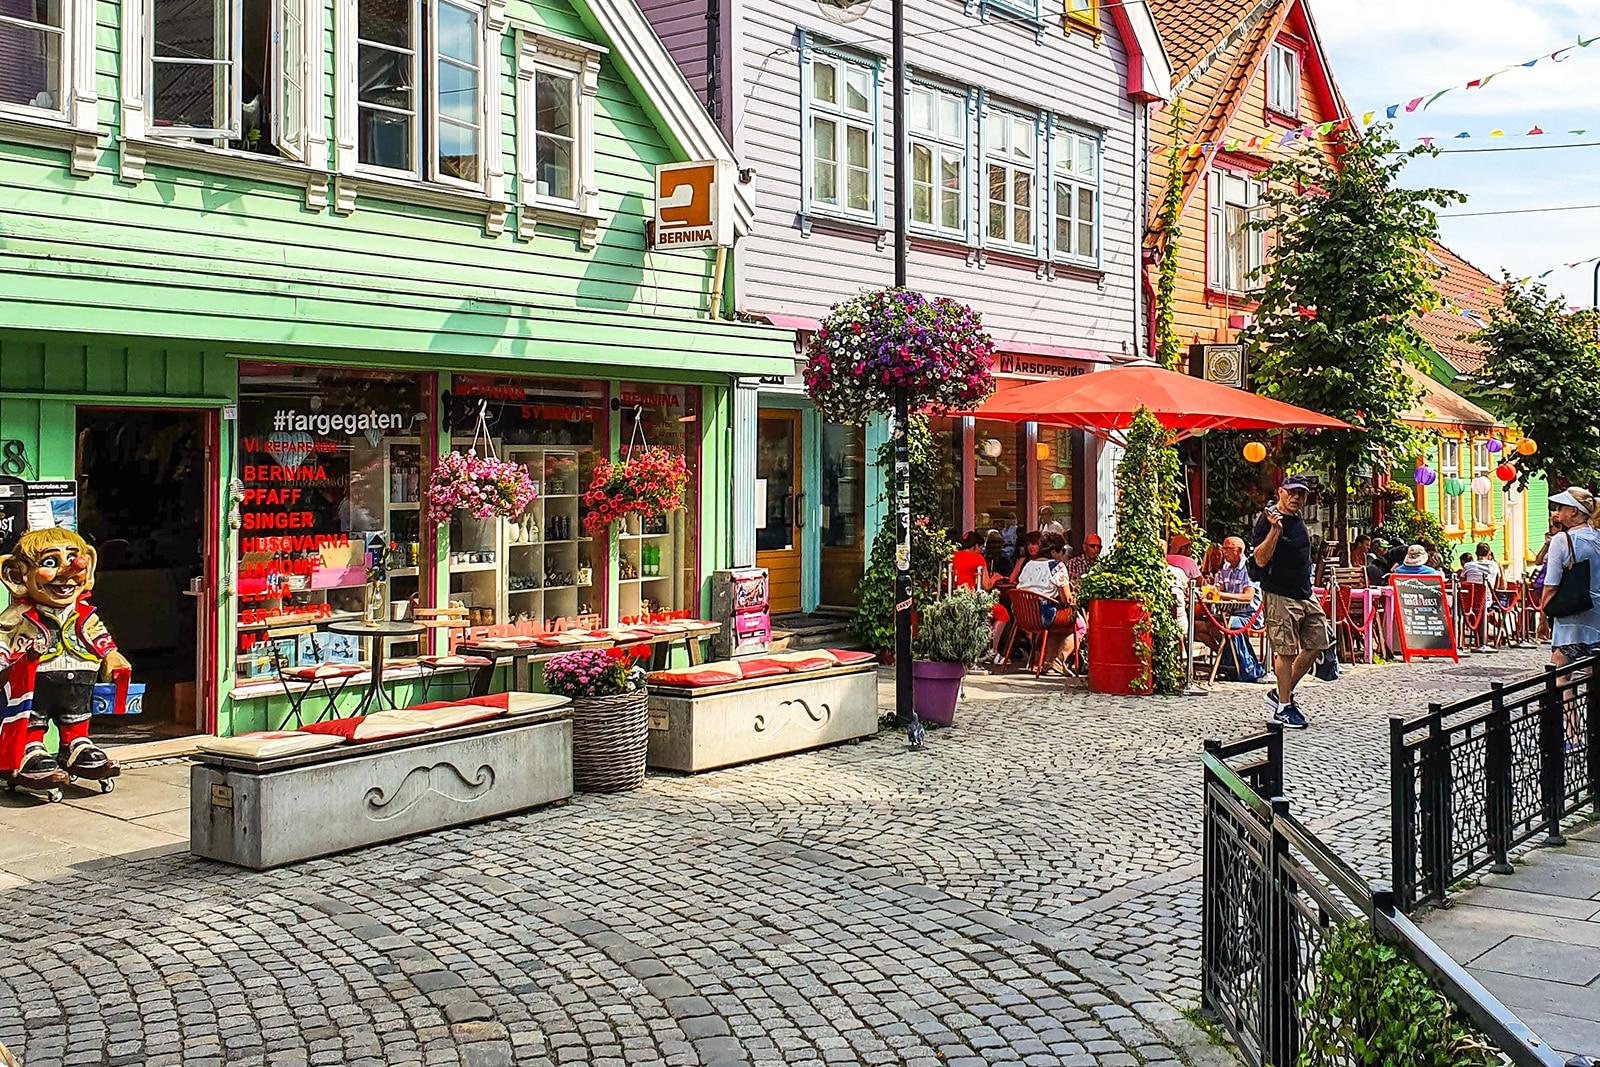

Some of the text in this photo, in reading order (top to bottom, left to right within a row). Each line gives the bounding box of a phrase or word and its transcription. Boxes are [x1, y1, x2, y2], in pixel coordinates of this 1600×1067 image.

[659, 229, 713, 244] BERNINA
[273, 409, 403, 435] #fargegaten
[243, 465, 327, 481] BERNINA
[244, 488, 302, 505] PFAFF
[0, 515, 15, 533] ST
[242, 511, 314, 530] SINGER
[242, 533, 350, 553] HUSQVARNA
